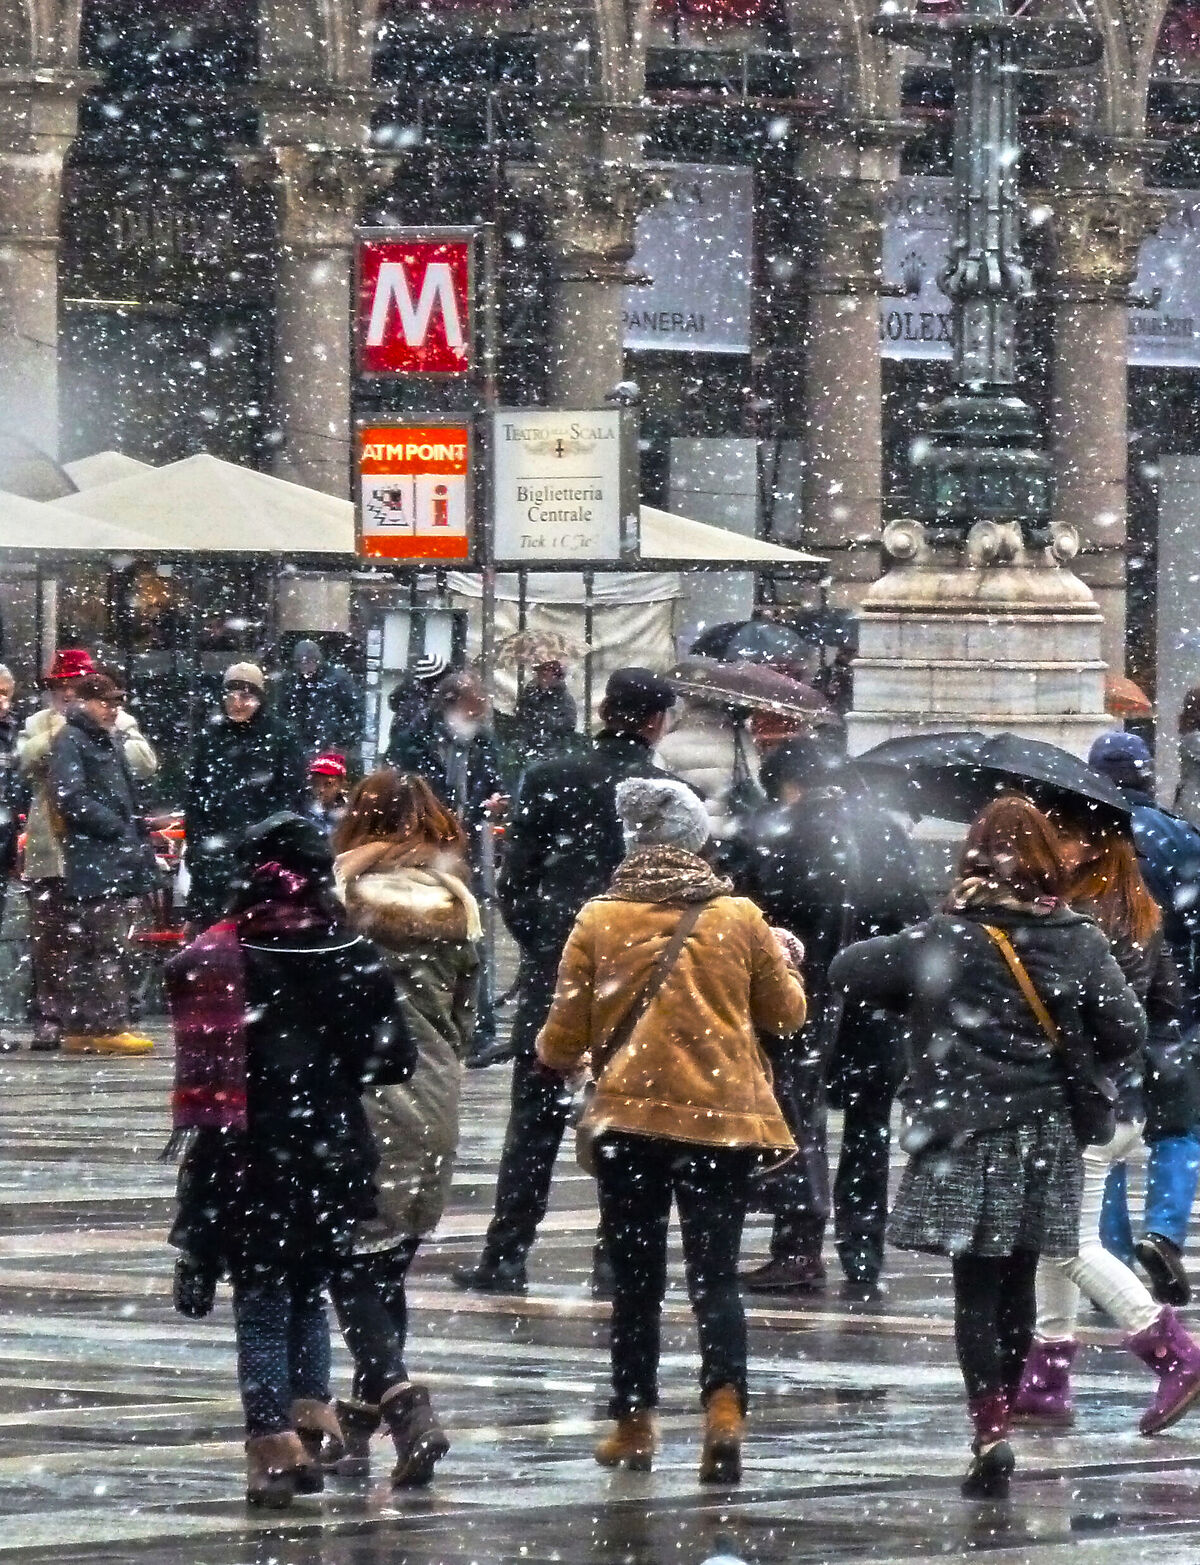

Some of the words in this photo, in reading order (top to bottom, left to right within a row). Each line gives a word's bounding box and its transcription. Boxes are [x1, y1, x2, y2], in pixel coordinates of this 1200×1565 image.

[366, 262, 463, 346] M
[570, 423, 615, 440] SCALA
[361, 444, 404, 461] ATM
[405, 444, 467, 461] POINT
[517, 485, 603, 505] Biglietteria
[528, 506, 593, 522] Centrale
[520, 534, 557, 548] Tickt
